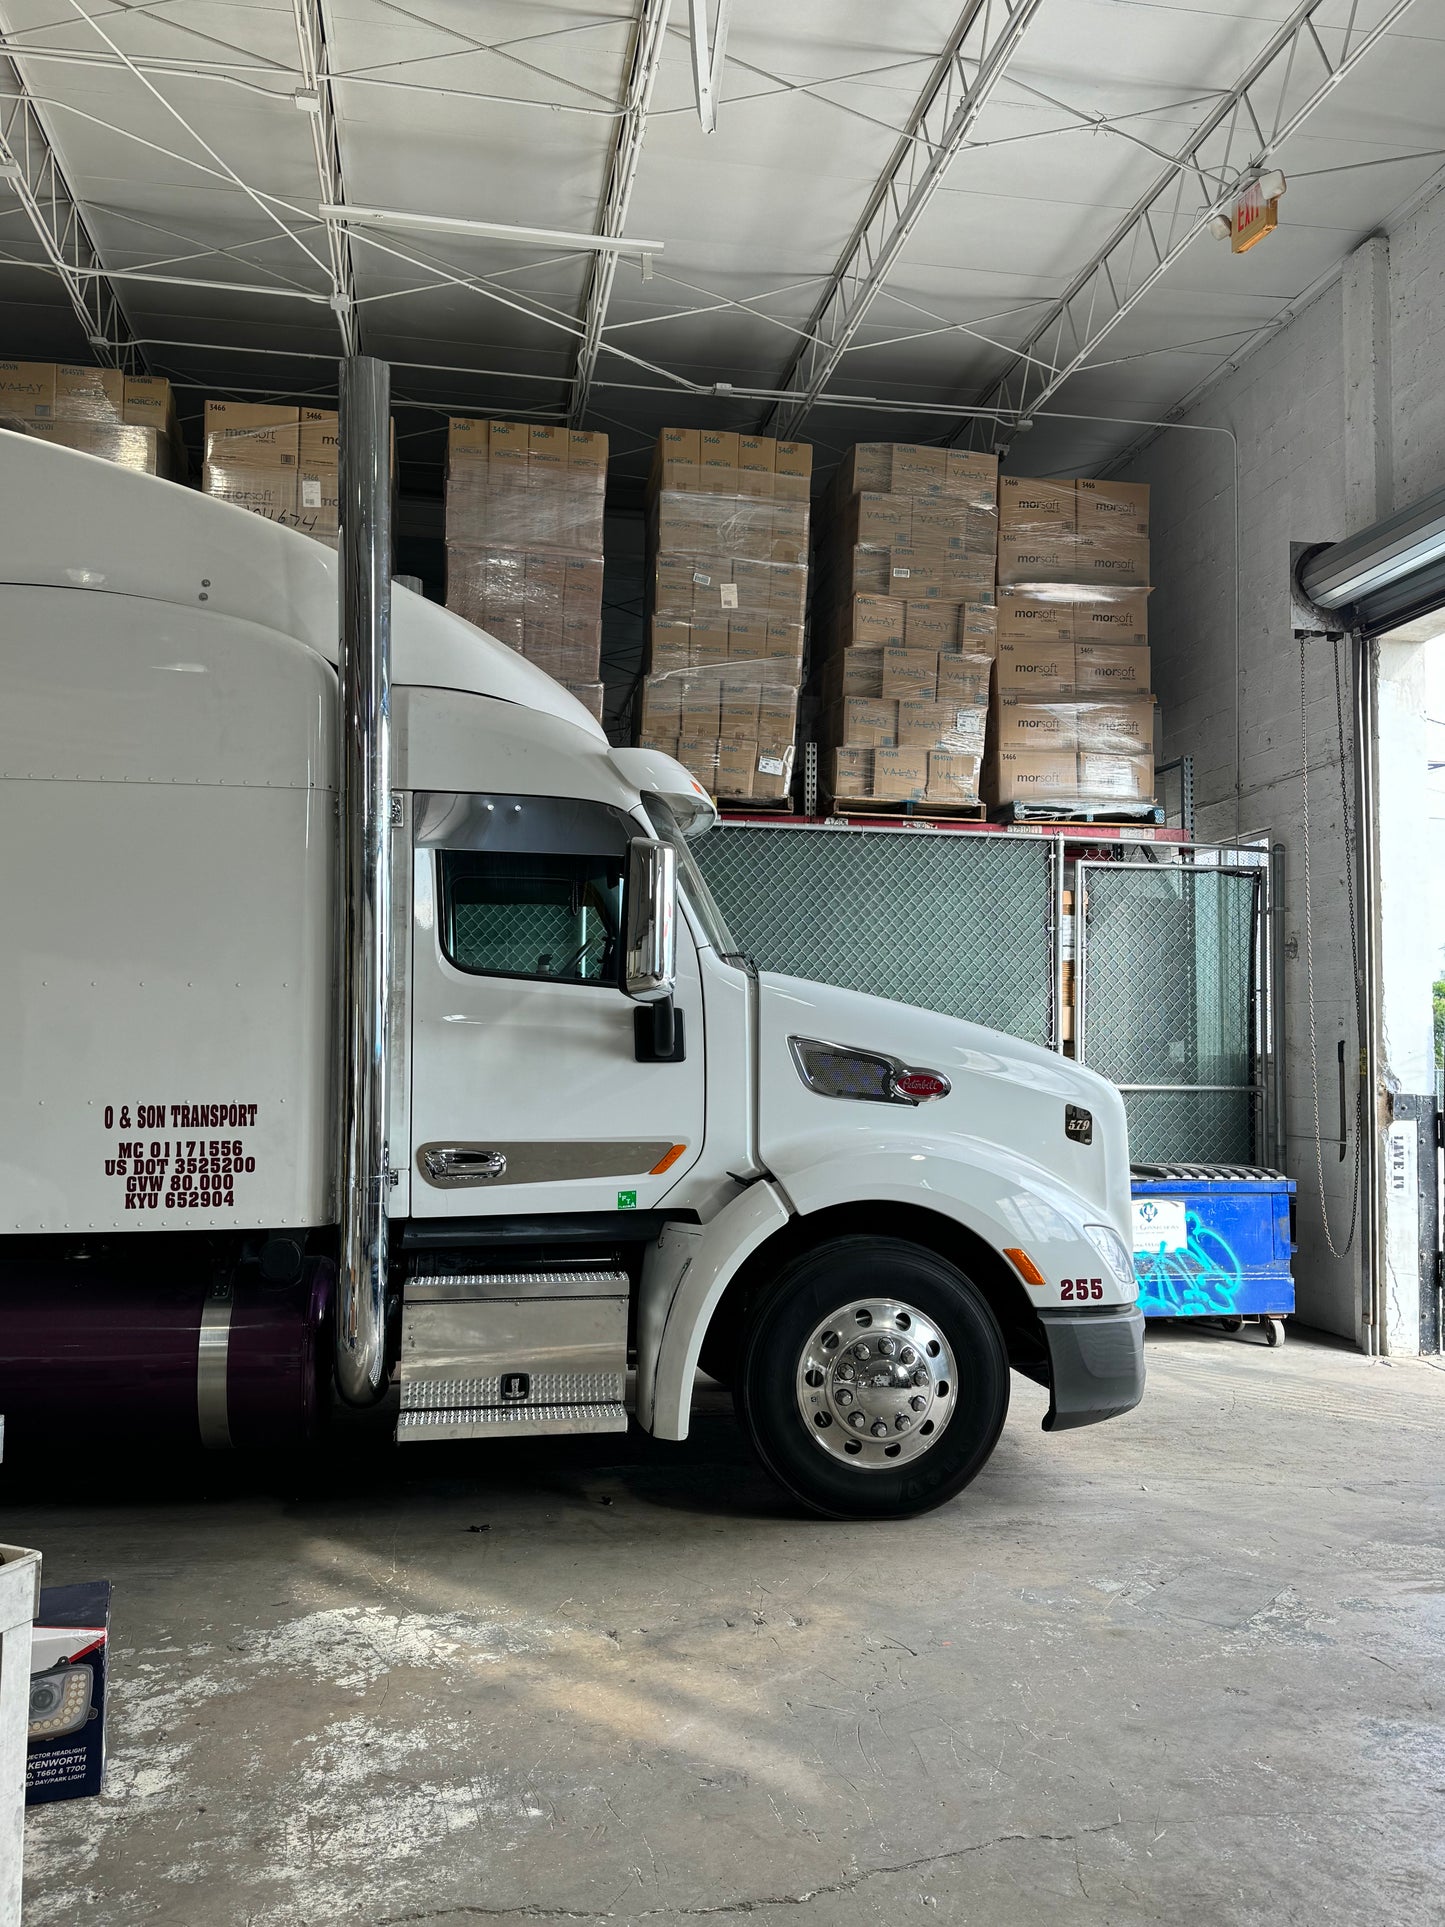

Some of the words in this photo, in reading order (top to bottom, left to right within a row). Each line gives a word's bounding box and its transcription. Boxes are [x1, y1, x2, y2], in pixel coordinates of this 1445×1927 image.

[1238, 183, 1260, 232] EXIT
[306, 412, 322, 420] 3466
[225, 427, 277, 440] morsoft
[665, 434, 682, 442] 3466
[742, 441, 758, 449] 3466
[778, 446, 794, 454] 3466
[1019, 499, 1061, 510] morsoft
[1096, 502, 1137, 513] morsoft
[1017, 553, 1060, 564] morsoft
[1094, 558, 1136, 569] morsoft
[1015, 609, 1058, 619] morsoft
[1092, 612, 1135, 623] morsoft
[1015, 662, 1059, 673] morsoft
[1095, 666, 1137, 677] morsoft
[1018, 718, 1060, 728] morsoft
[1017, 772, 1060, 783] morsoft
[902, 1078, 938, 1090] Peterbilt
[104, 1105, 114, 1129] O
[120, 1105, 132, 1129] &
[137, 1105, 166, 1128] SON
[171, 1104, 257, 1128] TRANSPORT
[1068, 1120, 1090, 1131] 579
[118, 1142, 144, 1158] MC
[150, 1140, 243, 1158] 01171556
[1393, 1136, 1404, 1169] LIVE
[105, 1160, 127, 1176] US
[133, 1159, 169, 1175] DOT
[175, 1157, 256, 1174] 3525200
[127, 1176, 165, 1193] GVW
[170, 1174, 234, 1191] 80.000
[125, 1193, 158, 1209] KYU
[165, 1191, 234, 1208] 652904
[1060, 1278, 1104, 1301] 255
[52, 1747, 87, 1757] HEADLIGHT
[28, 1754, 86, 1769] KENWORTH
[37, 1768, 57, 1778] T660
[58, 1767, 64, 1775] &
[66, 1764, 87, 1774] T700
[35, 1775, 67, 1785] DAY/PARK
[68, 1773, 87, 1781] LIGHT
